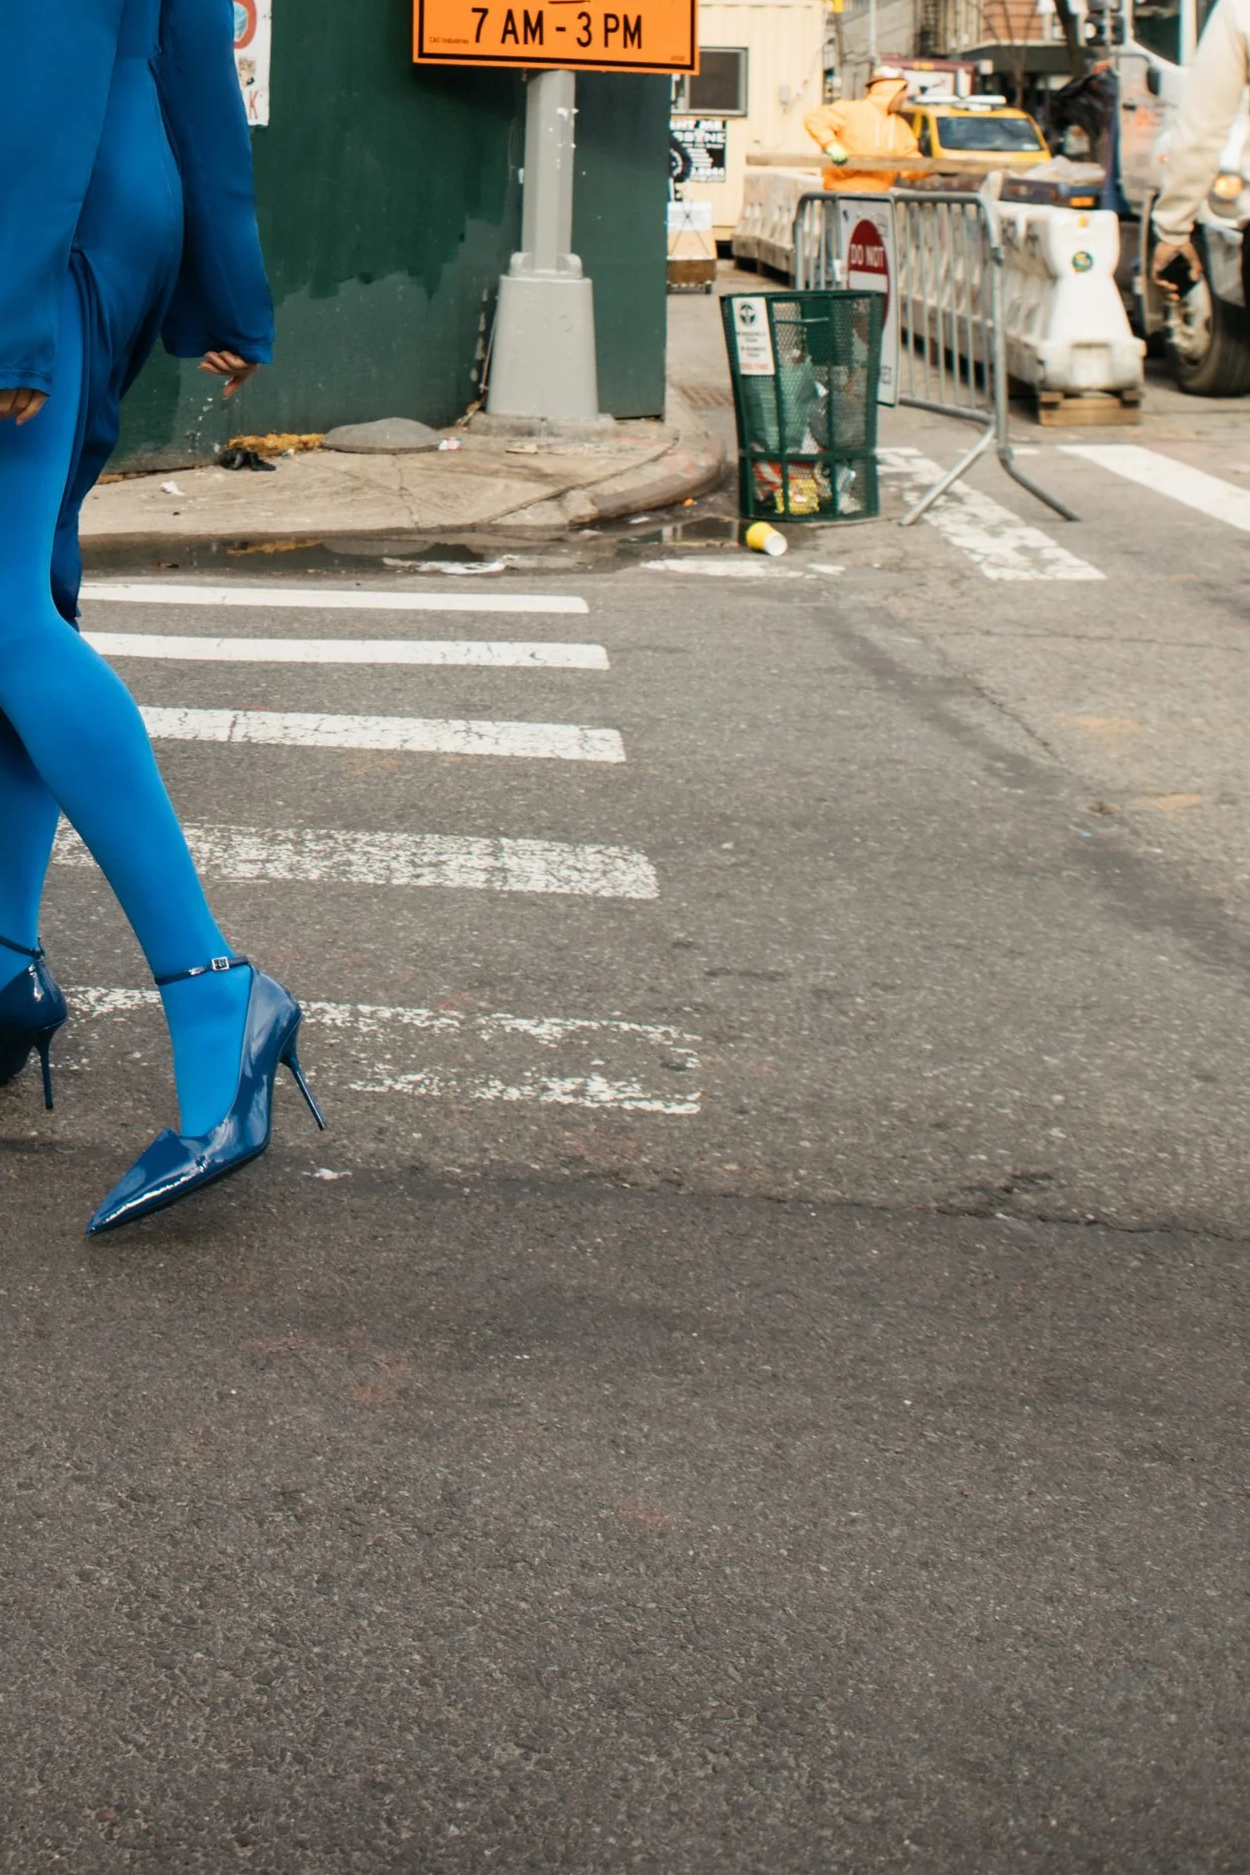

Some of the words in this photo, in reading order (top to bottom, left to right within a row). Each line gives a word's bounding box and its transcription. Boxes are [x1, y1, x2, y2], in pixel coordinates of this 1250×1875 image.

[471, 7, 489, 43] 7
[501, 10, 544, 45] AM
[576, 12, 592, 48] 3
[604, 13, 642, 49] PM
[850, 243, 864, 265] DO
[865, 245, 884, 267] NOT
